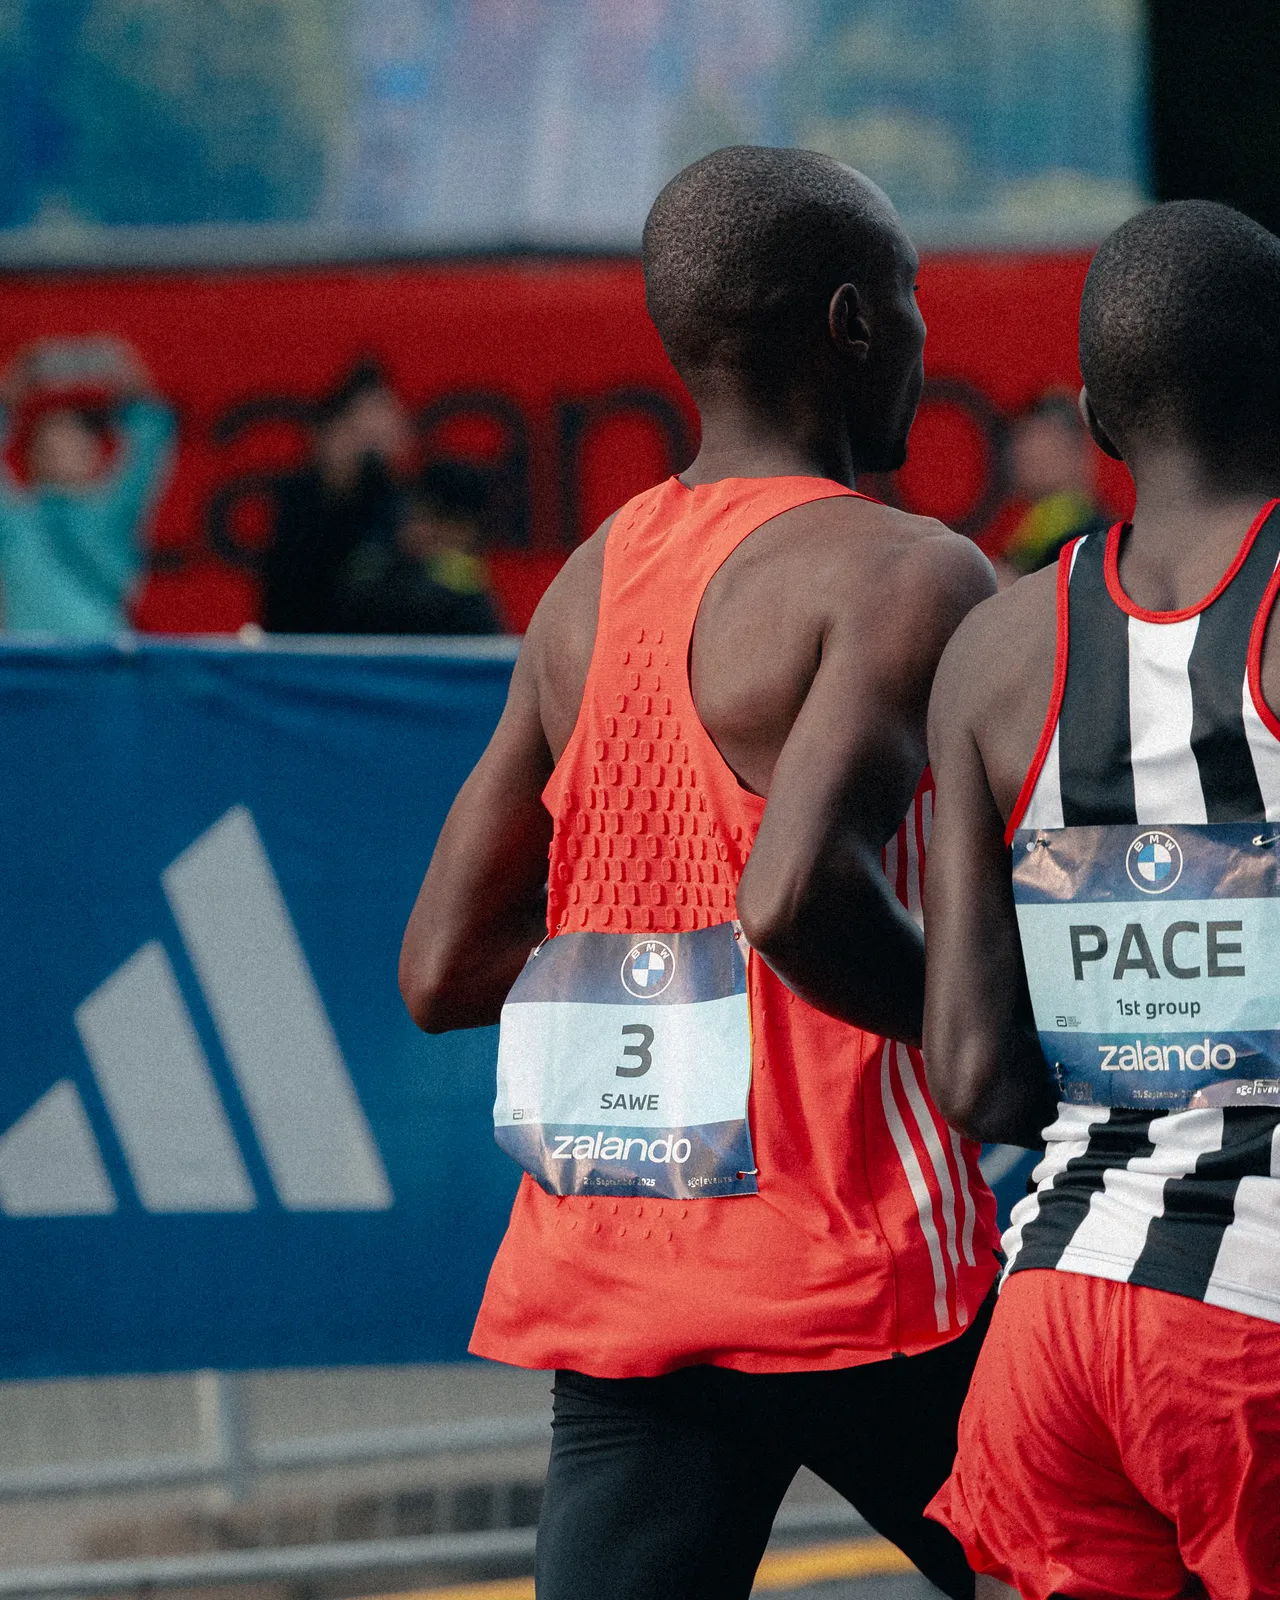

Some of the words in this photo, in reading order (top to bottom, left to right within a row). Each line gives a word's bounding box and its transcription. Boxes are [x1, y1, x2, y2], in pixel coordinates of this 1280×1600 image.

[1133, 834, 1176, 853] BMW
[630, 943, 670, 960] BMW
[1069, 920, 1246, 981] PACE
[1116, 998, 1141, 1016] 1st
[1145, 1000, 1201, 1019] group
[615, 1023, 655, 1078] 3
[1098, 1037, 1237, 1072] zalando
[600, 1093, 660, 1111] SAWE
[551, 1131, 692, 1164] zalando
[637, 1177, 656, 1187] 2025
